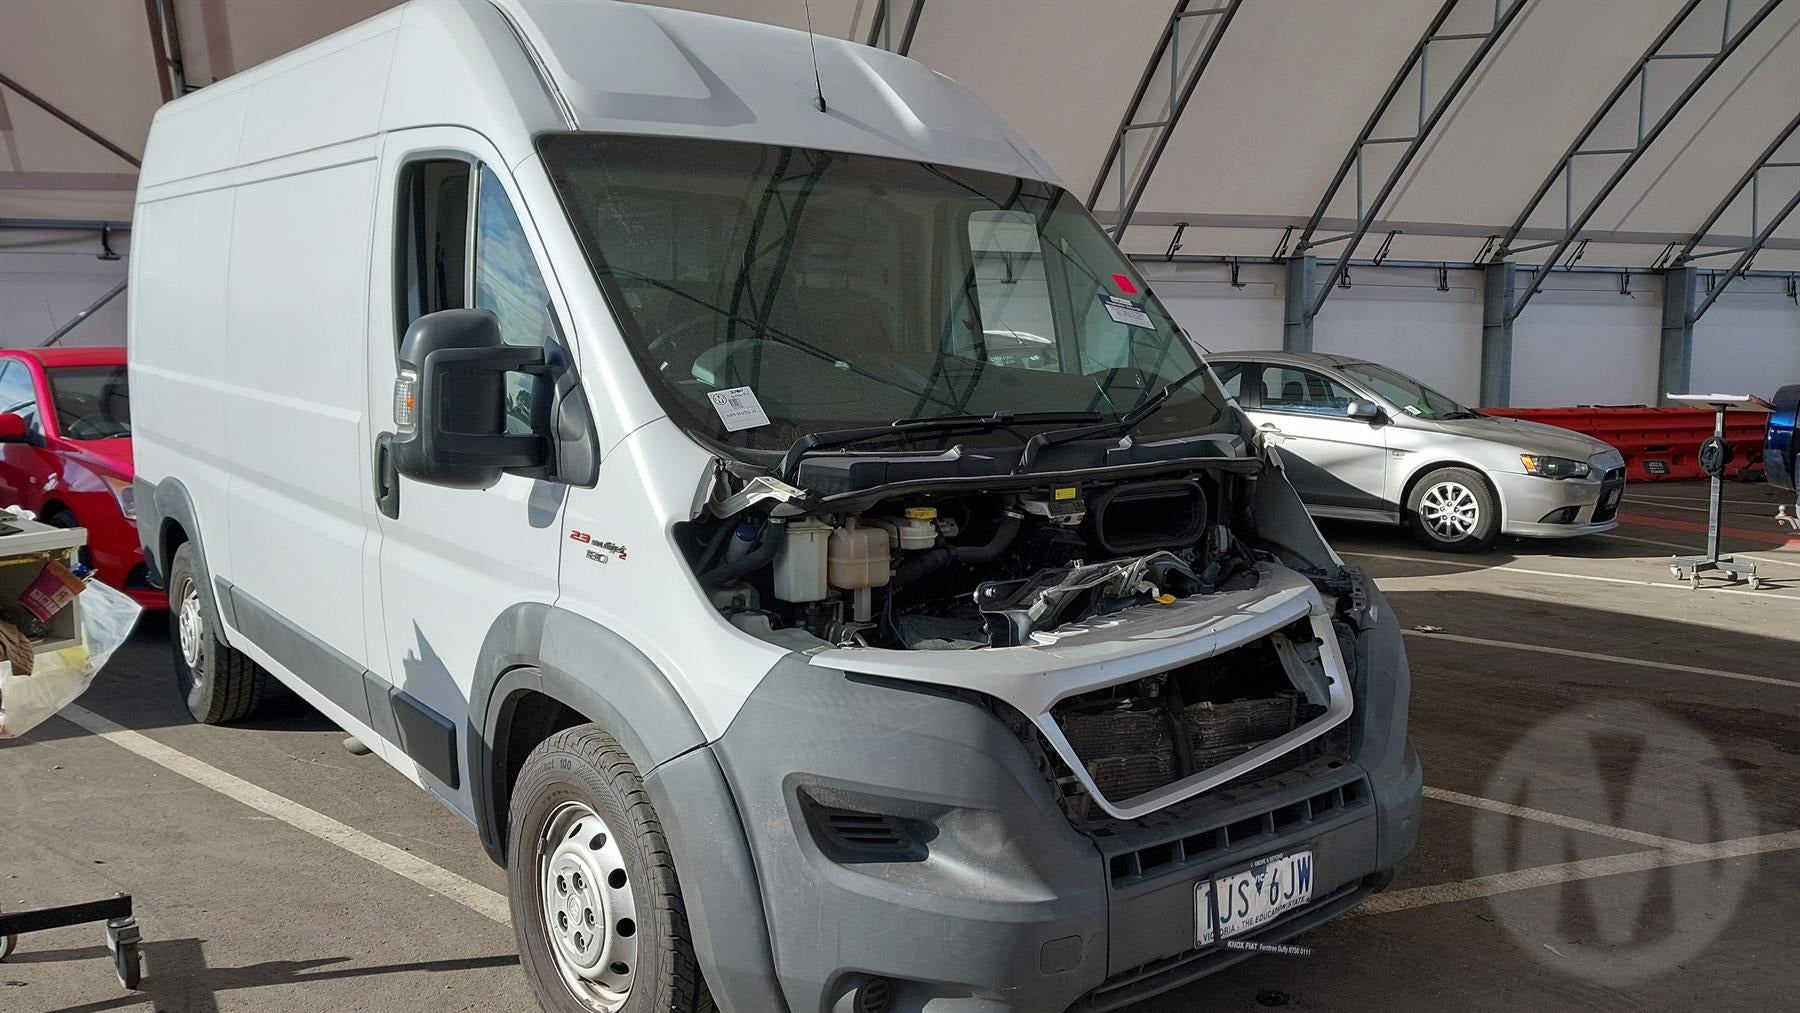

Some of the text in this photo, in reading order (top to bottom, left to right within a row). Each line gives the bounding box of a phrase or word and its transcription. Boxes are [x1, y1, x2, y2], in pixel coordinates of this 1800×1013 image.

[1269, 855, 1311, 906] 6JW
[1203, 925, 1236, 942] VICORIA
[1241, 917, 1254, 929] THE
[1287, 895, 1306, 911] STATE
[1227, 941, 1245, 949] KNOX
[1245, 942, 1258, 950] FIAT
